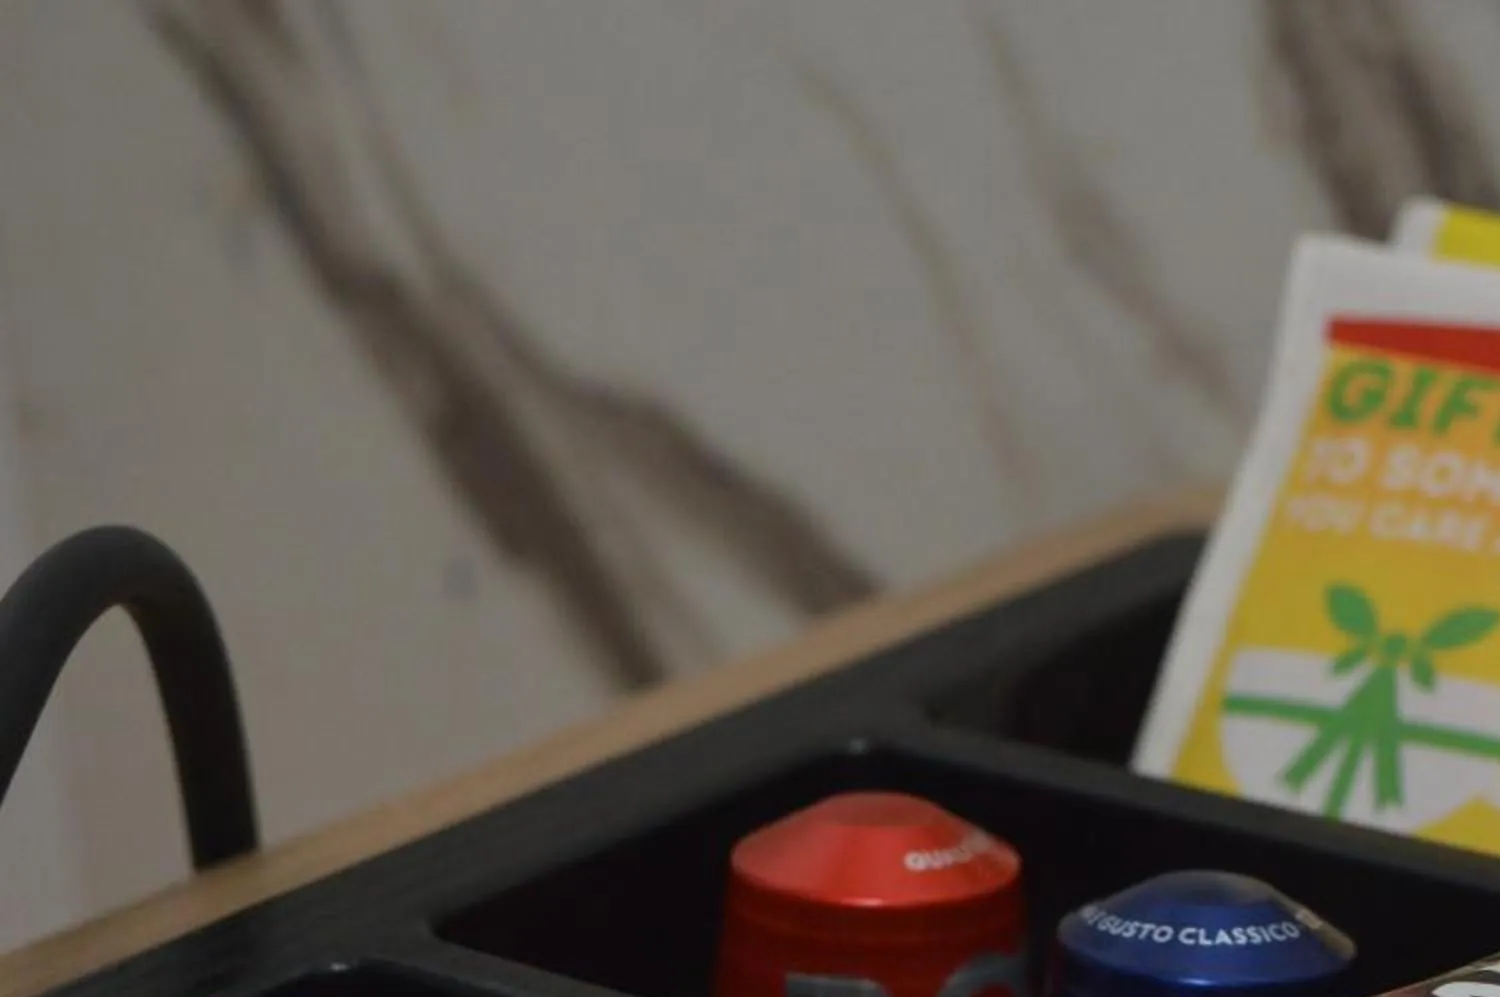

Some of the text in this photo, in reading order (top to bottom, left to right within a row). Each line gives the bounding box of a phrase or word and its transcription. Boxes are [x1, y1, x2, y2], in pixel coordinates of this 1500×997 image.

[1306, 436, 1372, 485] TO
[1287, 492, 1365, 536] YOU
[1368, 501, 1491, 553] CARE
[1096, 914, 1174, 944] GUSTO
[1178, 918, 1301, 947] CLASSICO
